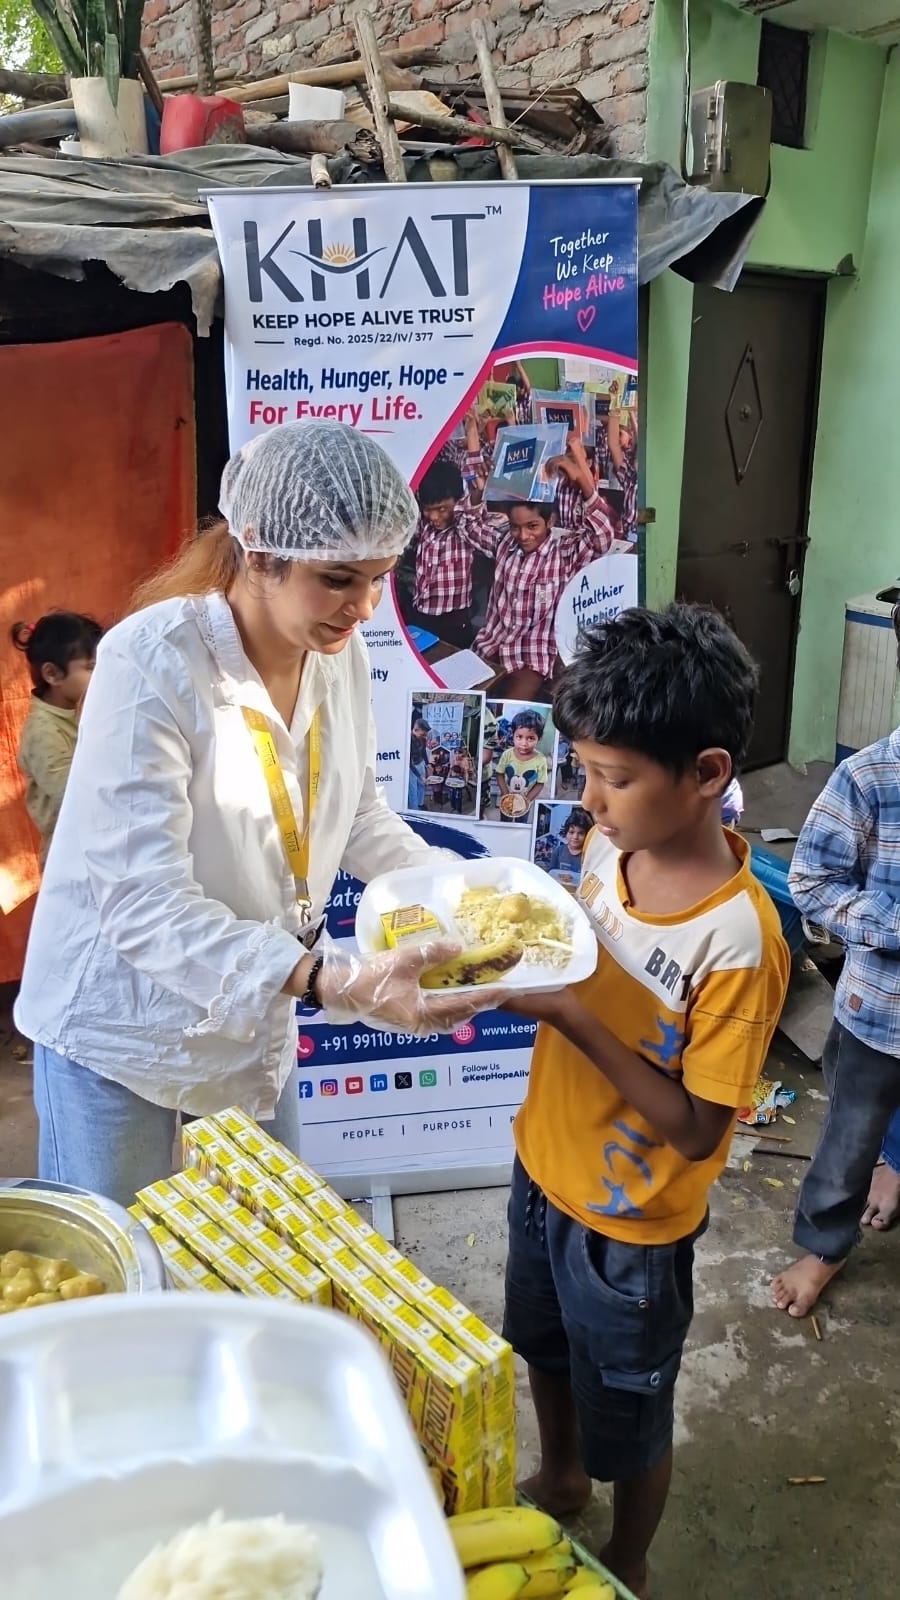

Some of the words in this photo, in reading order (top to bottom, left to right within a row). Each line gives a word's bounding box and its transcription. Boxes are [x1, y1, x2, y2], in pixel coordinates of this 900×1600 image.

[549, 228, 610, 259] Together
[243, 213, 486, 303] KHAT
[556, 260, 578, 281] We
[582, 253, 614, 274] Keep
[542, 283, 582, 311] Hope
[585, 272, 625, 300] Alive
[252, 313, 299, 329] KEEP
[304, 312, 356, 328] HOPE
[361, 310, 414, 326] ALIVE
[418, 307, 475, 324] TRUST
[293, 336, 324, 347] Regd.
[327, 335, 345, 345] No.
[415, 332, 434, 342] 377
[246, 368, 314, 393] Health,
[320, 367, 393, 392] Hunger,
[399, 365, 448, 390] Hope
[249, 400, 288, 424] For
[371, 395, 423, 421] Life.
[580, 575, 590, 593] A
[572, 584, 625, 615] Healthier
[360, 629, 395, 638] tationery
[481, 1021, 539, 1036] www.keep
[320, 1036, 348, 1052] +91
[352, 1032, 393, 1049] 99110
[462, 1064, 488, 1073] Follow
[489, 1063, 500, 1071] Us
[342, 1127, 385, 1140] PEOPLE
[422, 1119, 472, 1132] PURPOSE
